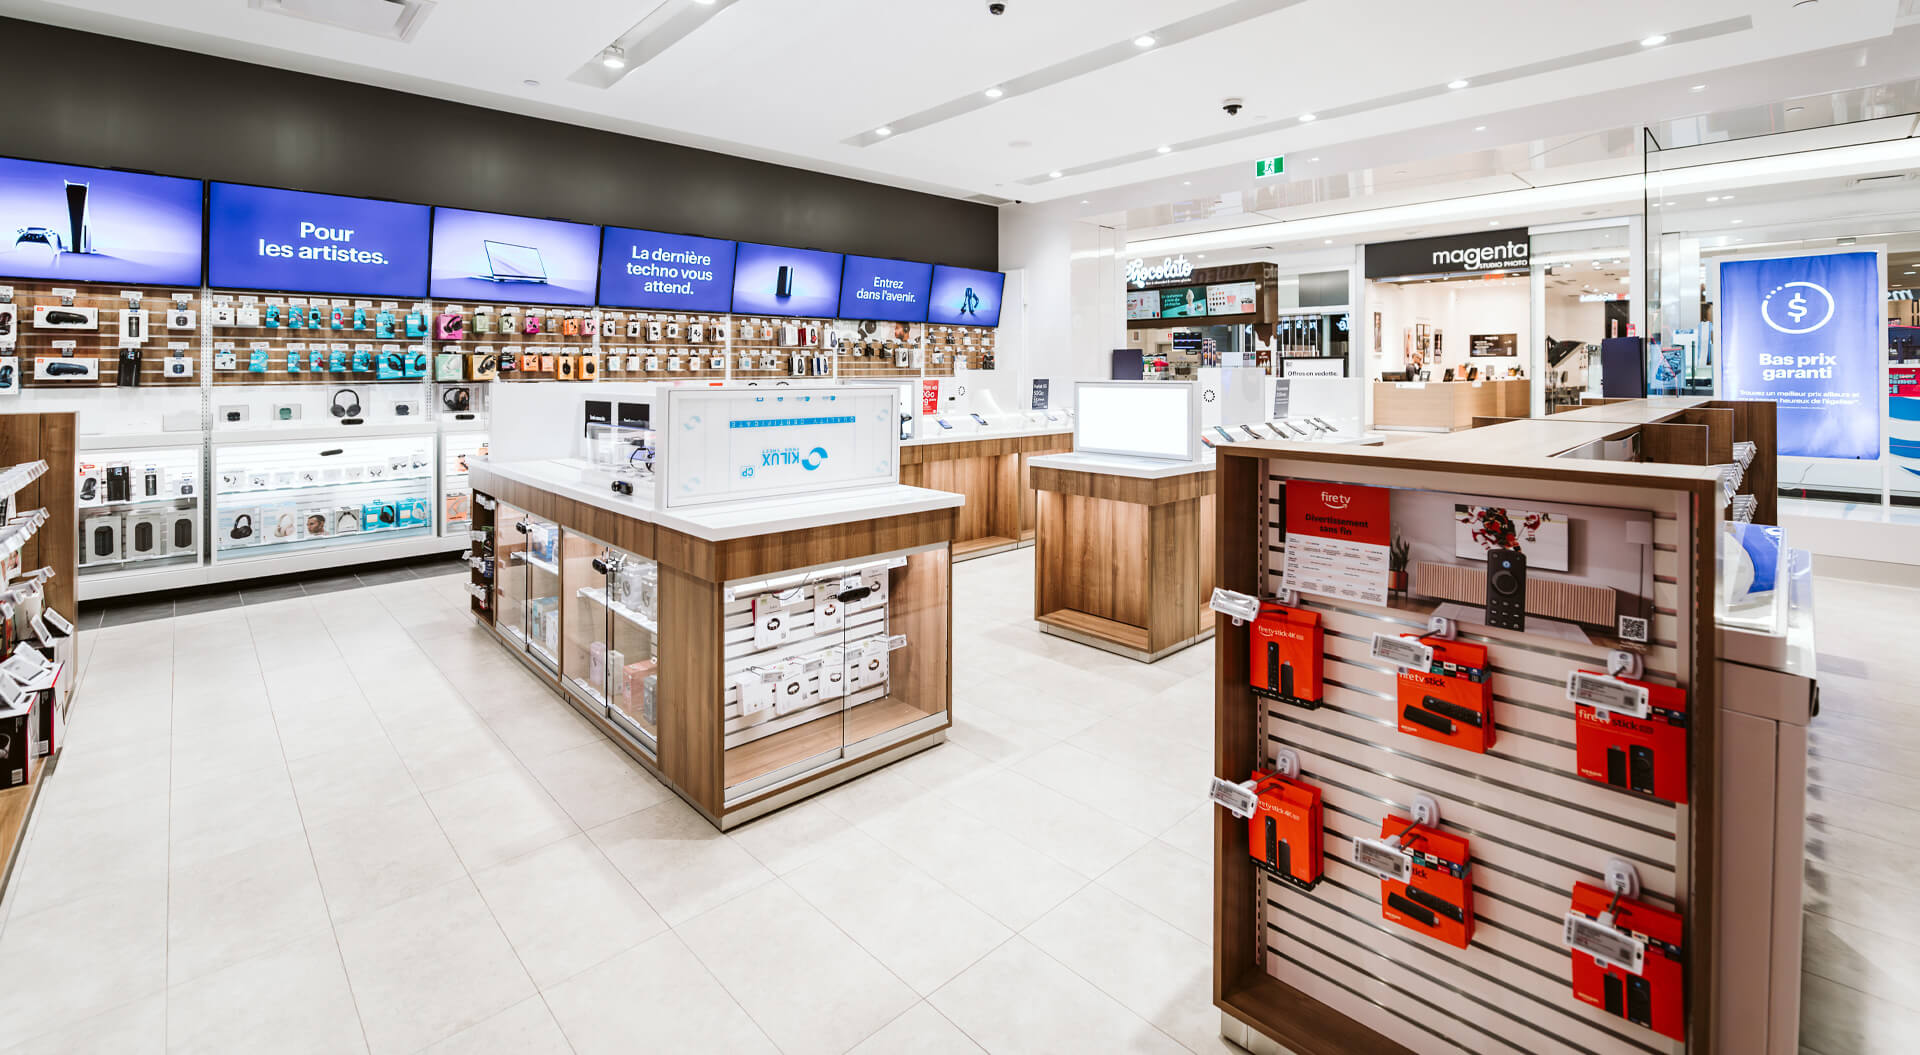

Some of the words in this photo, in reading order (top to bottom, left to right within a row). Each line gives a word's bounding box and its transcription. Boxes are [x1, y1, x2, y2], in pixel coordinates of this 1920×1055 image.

[299, 221, 354, 242] Pour
[258, 238, 294, 258] les
[298, 244, 389, 265] artistes.
[632, 245, 650, 260] La
[652, 247, 711, 265] dernière
[1432, 241, 1528, 270] magenta
[1503, 259, 1528, 268] PHOTO
[627, 262, 678, 278] techno
[681, 266, 713, 281] vous
[644, 280, 694, 295] attend.
[873, 276, 904, 290] Entrez
[856, 288, 881, 301] dans
[882, 290, 916, 303] l'avenir.
[1759, 353, 1794, 366] Bas
[1797, 353, 1837, 370] prix
[1762, 366, 1833, 381] garanti
[762, 451, 800, 466] KILUX
[742, 466, 754, 477] CP
[1305, 513, 1369, 528] Divertissement
[1319, 525, 1338, 534] sans
[1340, 526, 1352, 536] fin
